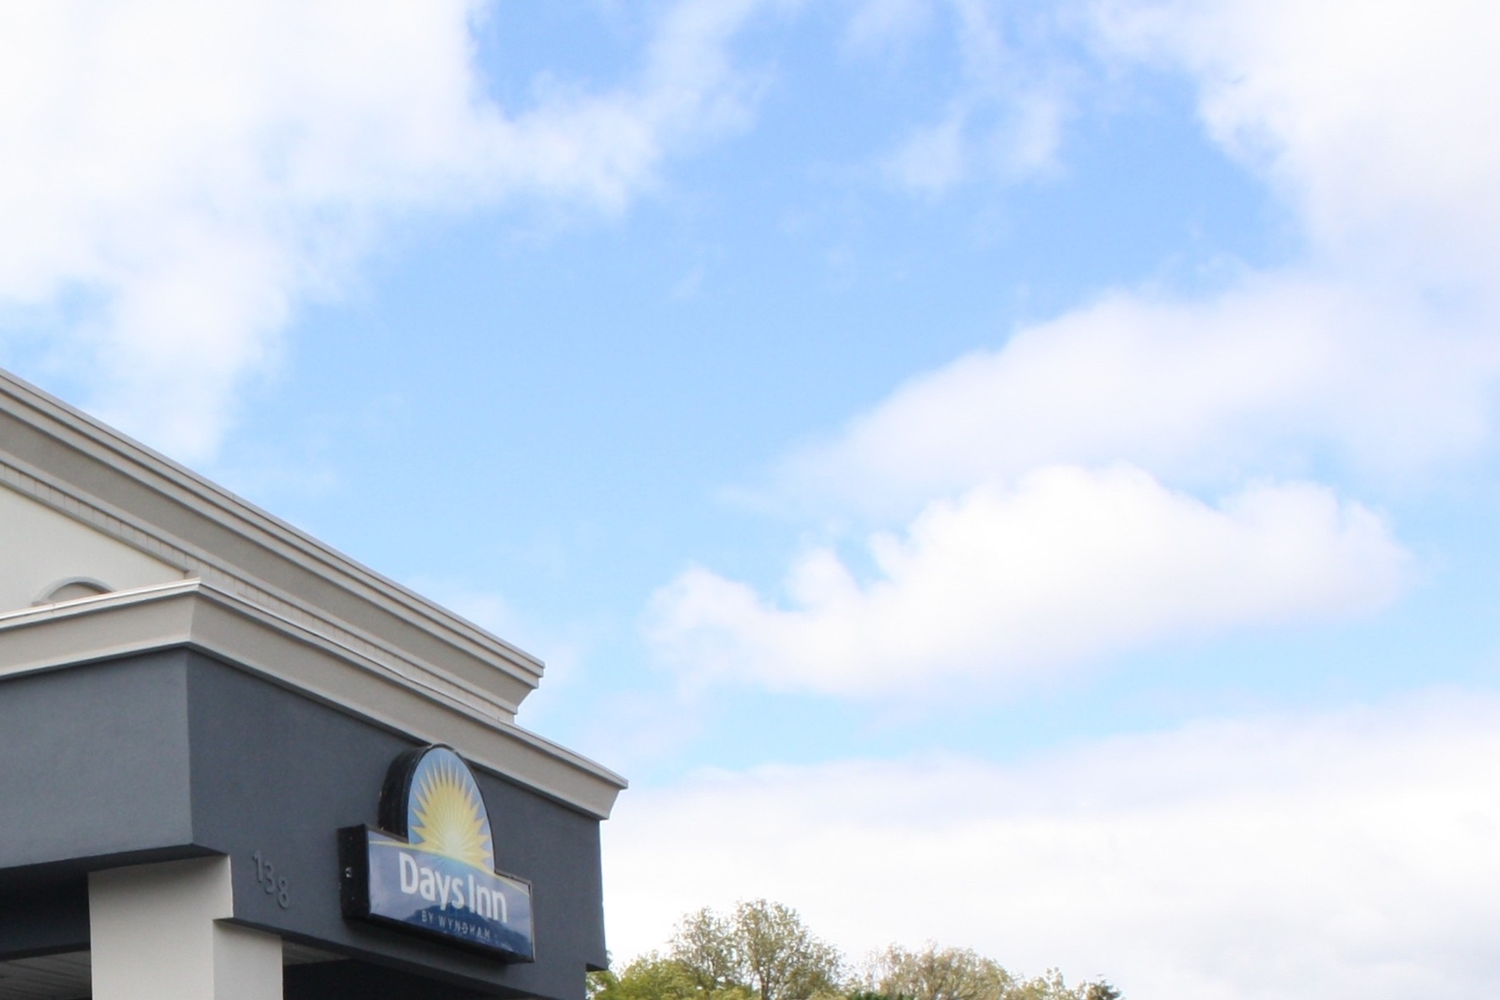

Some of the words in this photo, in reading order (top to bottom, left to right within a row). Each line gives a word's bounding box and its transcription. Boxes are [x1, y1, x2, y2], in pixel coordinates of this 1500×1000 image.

[252, 850, 289, 909] 138
[399, 851, 465, 911] Days
[468, 874, 508, 923] Inn
[422, 910, 435, 923] BY
[438, 915, 491, 940] WYNDHAM
